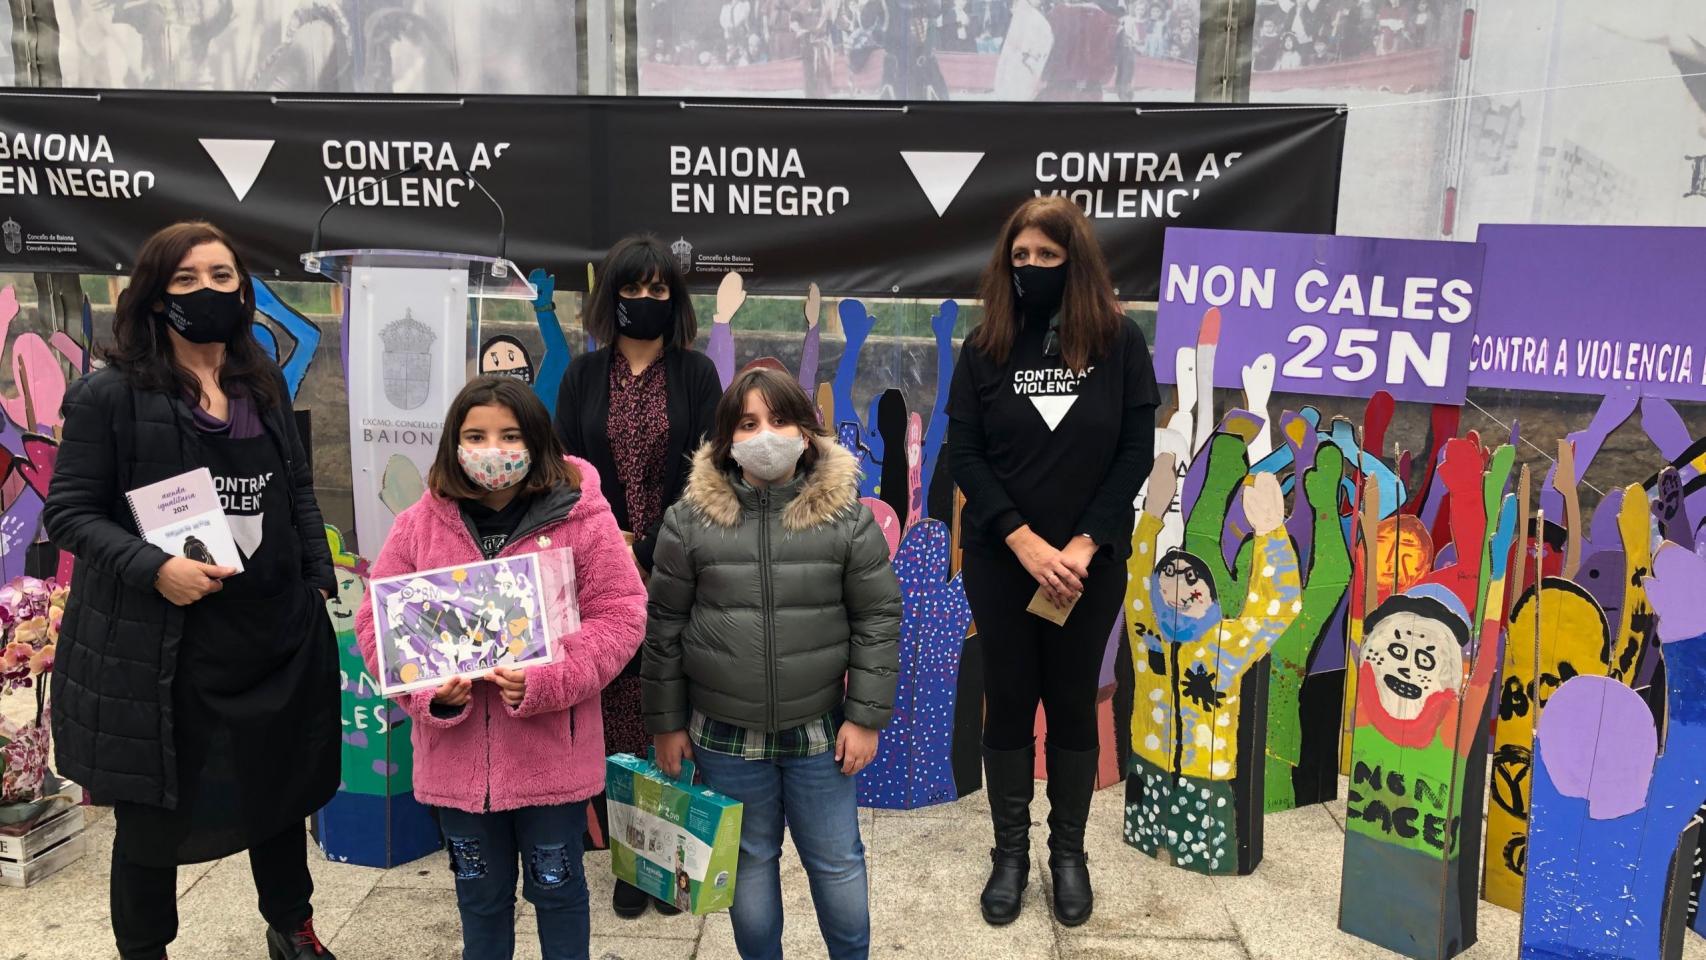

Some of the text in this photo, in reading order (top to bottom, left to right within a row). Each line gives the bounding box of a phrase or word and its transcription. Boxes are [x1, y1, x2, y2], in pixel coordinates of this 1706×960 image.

[0, 132, 114, 163] BAIONA
[322, 140, 459, 171] CONTRA
[670, 145, 805, 178] BAIONA
[0, 165, 155, 199] EN NEGRO
[1035, 151, 1184, 183] CONTRA
[324, 176, 475, 207] VIOLENC
[671, 182, 850, 216] EN NEGRO
[1166, 263, 1473, 324] NON CALES
[1282, 324, 1451, 388] 25N
[1469, 333, 1549, 376] CONTRA
[1553, 338, 1568, 377] A
[1577, 339, 1693, 384] VIOLENCIA
[1013, 380, 1080, 395] VIOLENC
[1014, 368, 1074, 383] CONTRA
[363, 428, 434, 446] BAION
[395, 420, 438, 429] CONCELLO
[172, 504, 189, 514] 2021
